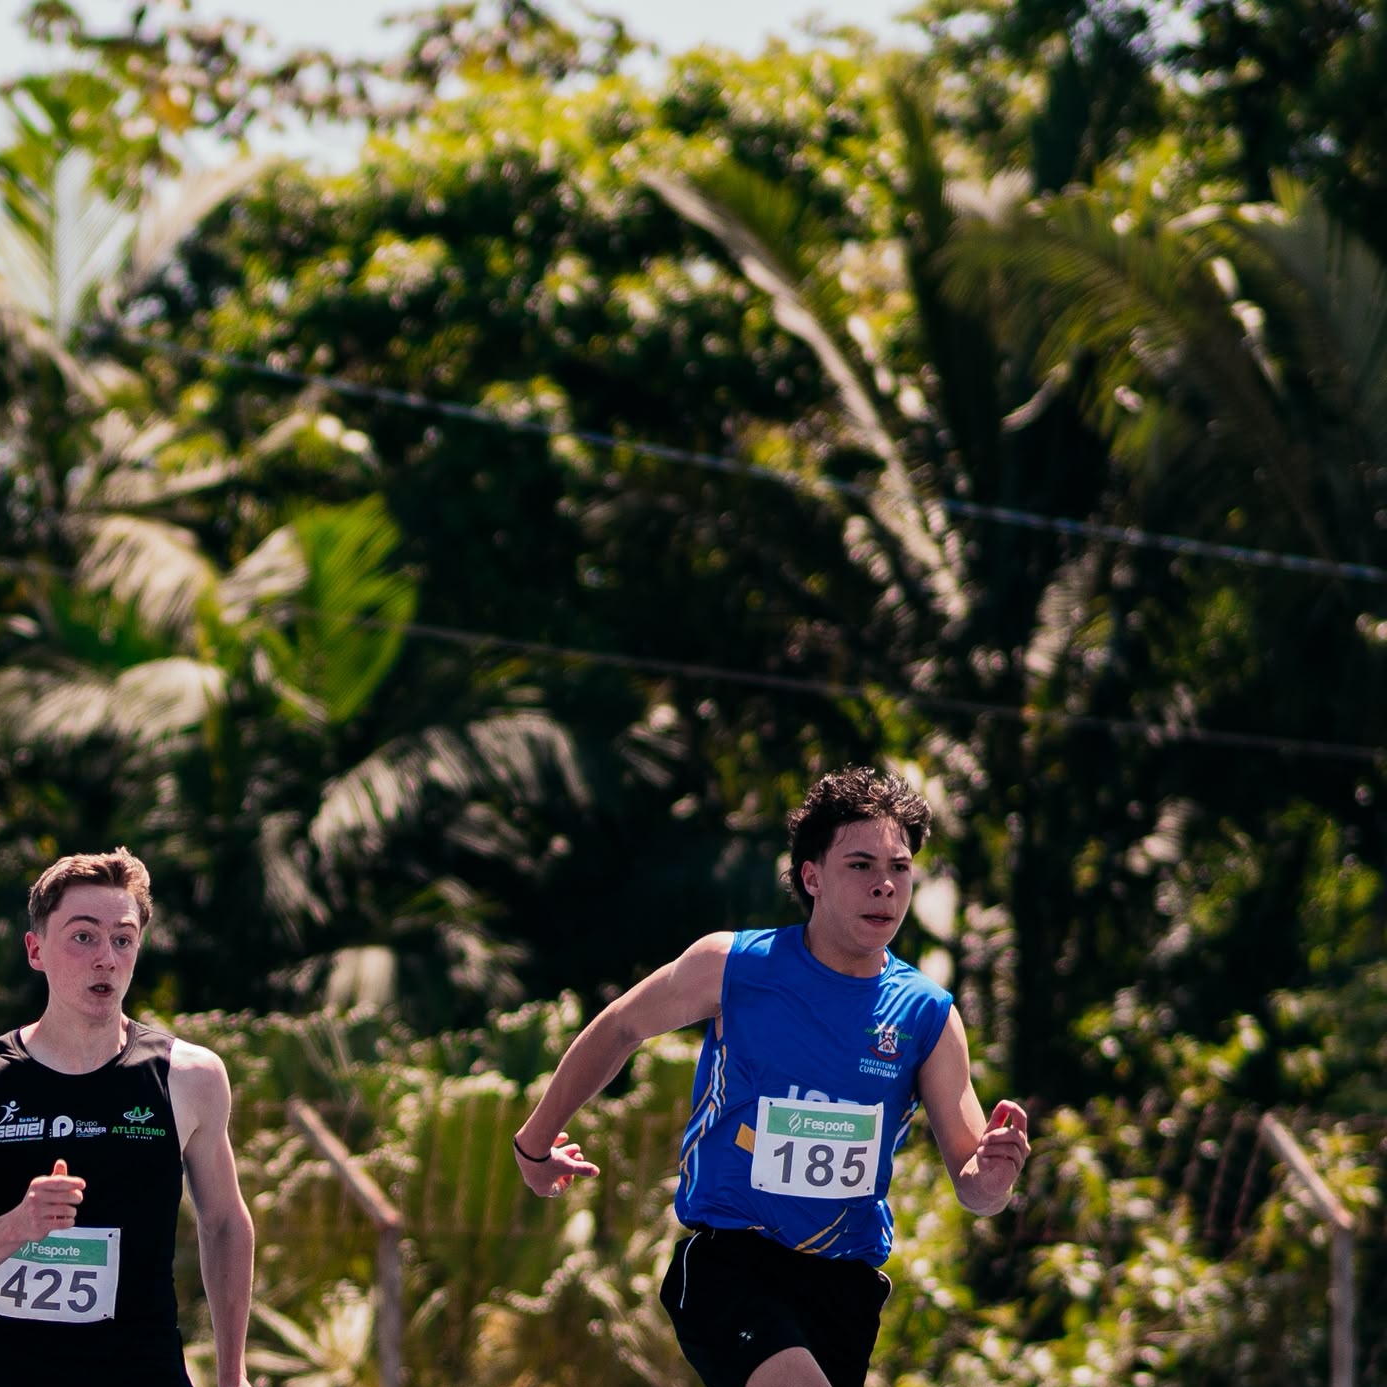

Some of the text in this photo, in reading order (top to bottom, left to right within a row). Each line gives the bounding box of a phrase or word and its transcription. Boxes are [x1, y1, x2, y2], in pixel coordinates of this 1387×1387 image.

[860, 1058, 896, 1072] PREFEITURA
[75, 1120, 98, 1128] Grupo
[75, 1126, 107, 1134] PLANNER
[803, 1118, 856, 1133] Fesporte
[111, 1126, 166, 1137] ATLETISMO
[773, 1141, 868, 1188] 185
[31, 1242, 81, 1258] Fesporte
[0, 1264, 98, 1313] 425
